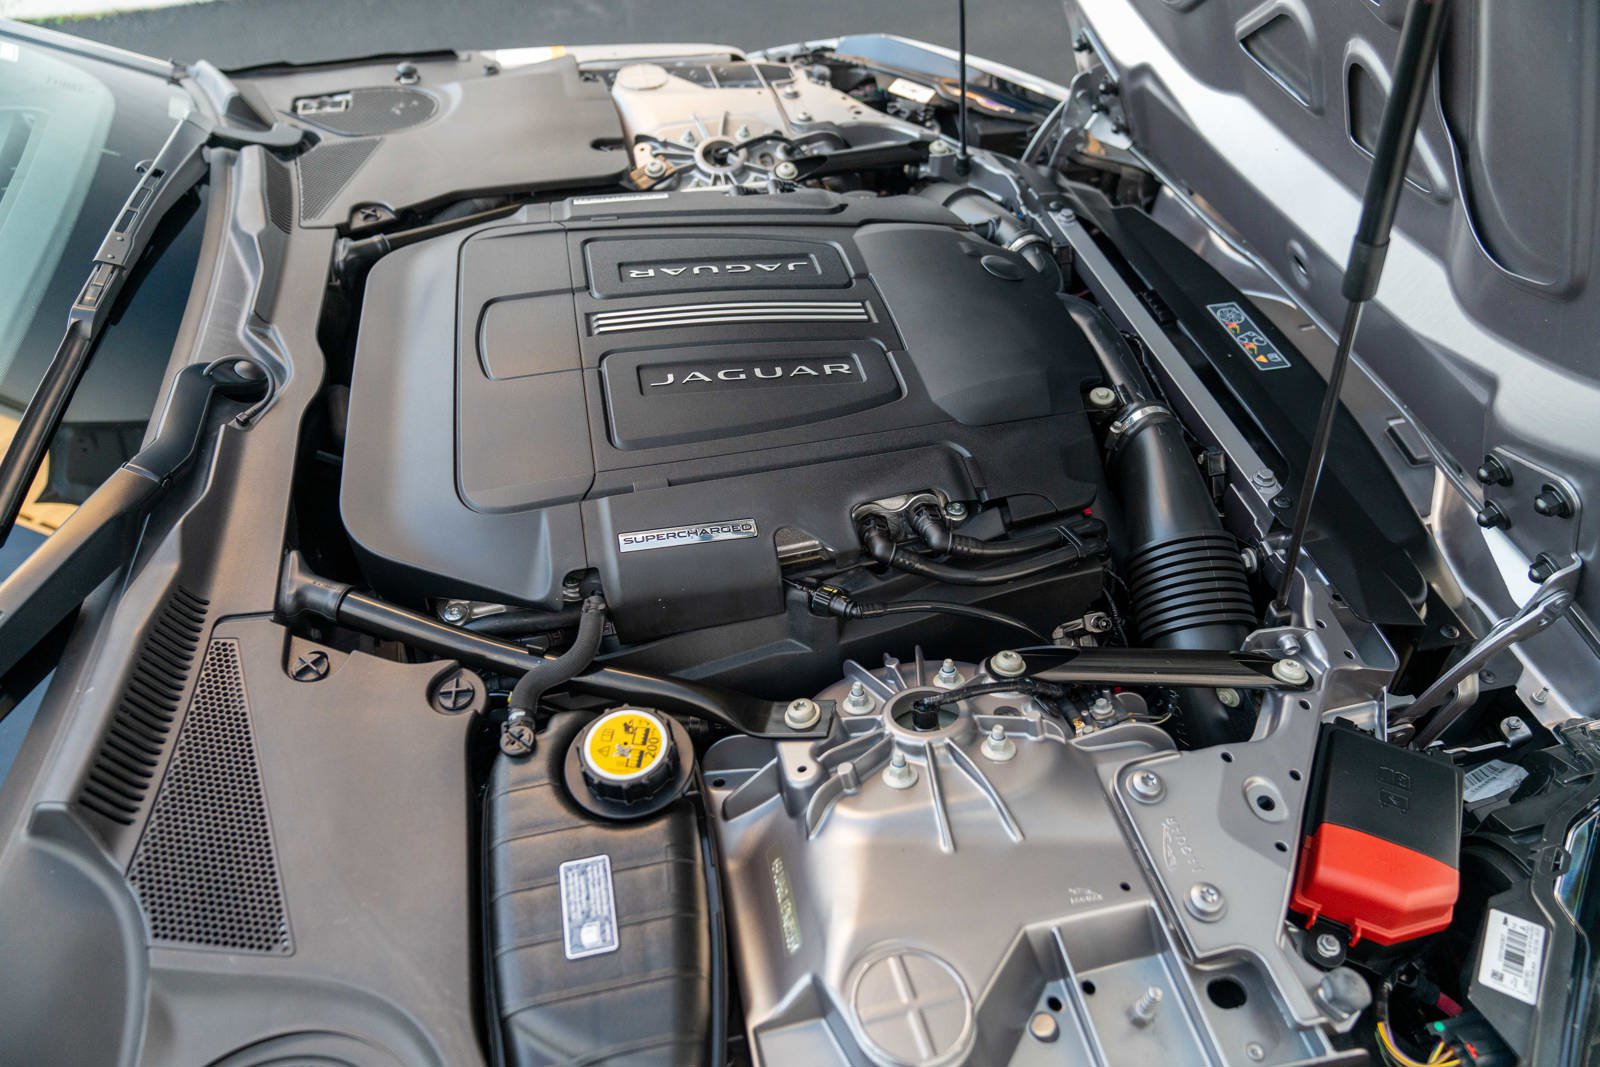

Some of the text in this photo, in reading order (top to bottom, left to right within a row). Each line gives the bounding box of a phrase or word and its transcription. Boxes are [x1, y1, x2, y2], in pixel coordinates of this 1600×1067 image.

[629, 262, 808, 278] JAGUAR
[651, 363, 853, 386] JAGUAR
[624, 523, 752, 544] SUPERCHARGED
